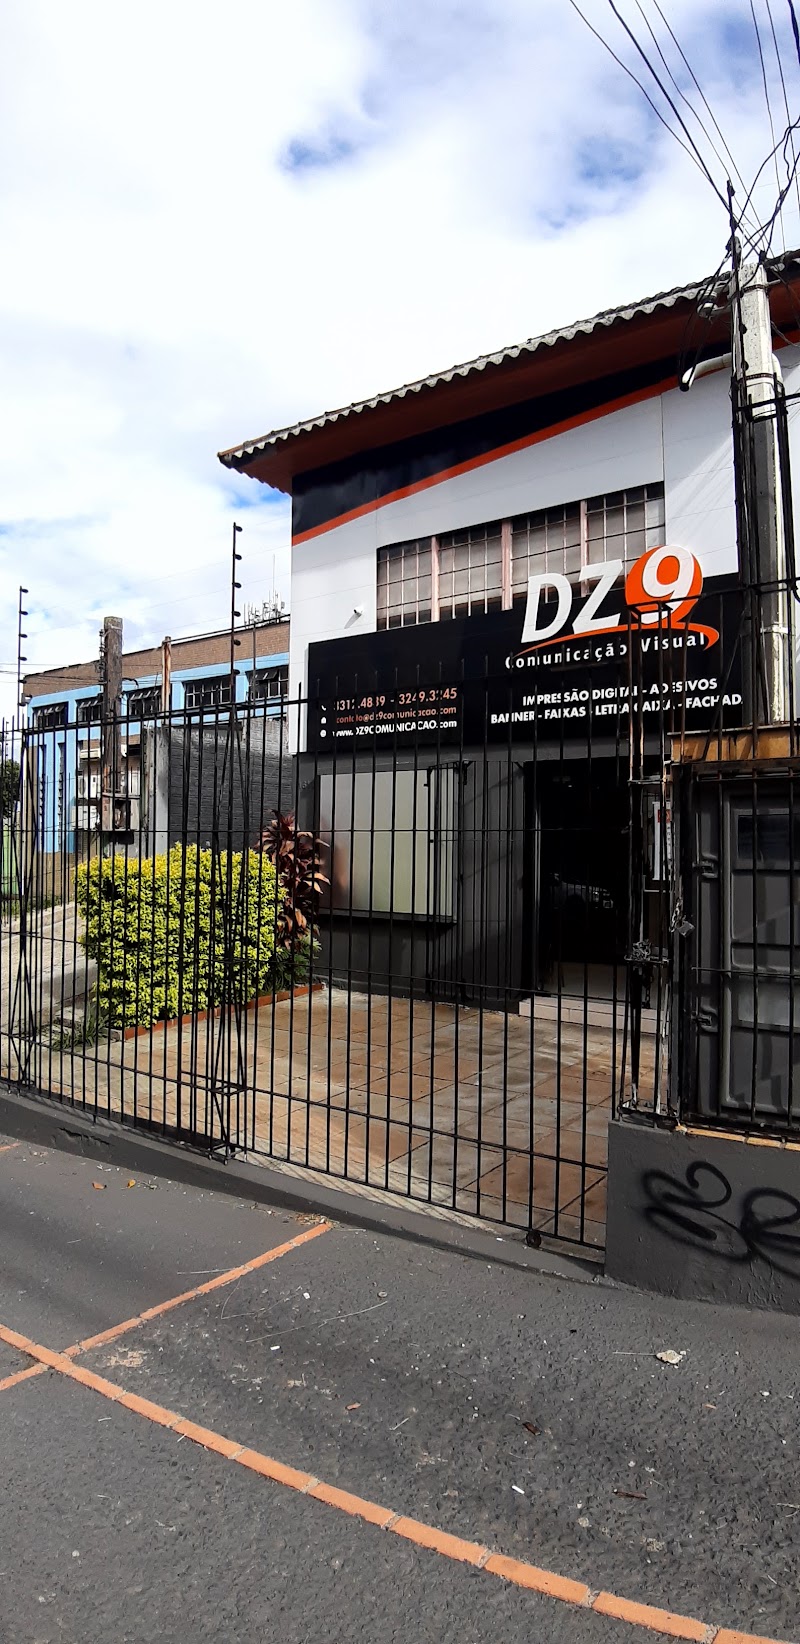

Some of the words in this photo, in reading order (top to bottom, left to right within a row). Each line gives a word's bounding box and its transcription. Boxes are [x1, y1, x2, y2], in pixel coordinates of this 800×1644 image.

[521, 544, 694, 643] DZ9
[505, 643, 628, 669] Comunicação
[641, 631, 705, 653] Visual
[491, 711, 535, 724] BANNER
[544, 706, 586, 719] FAIXAS
[685, 693, 743, 709] FACHAD
[522, 688, 589, 706] IMPRESSÃO
